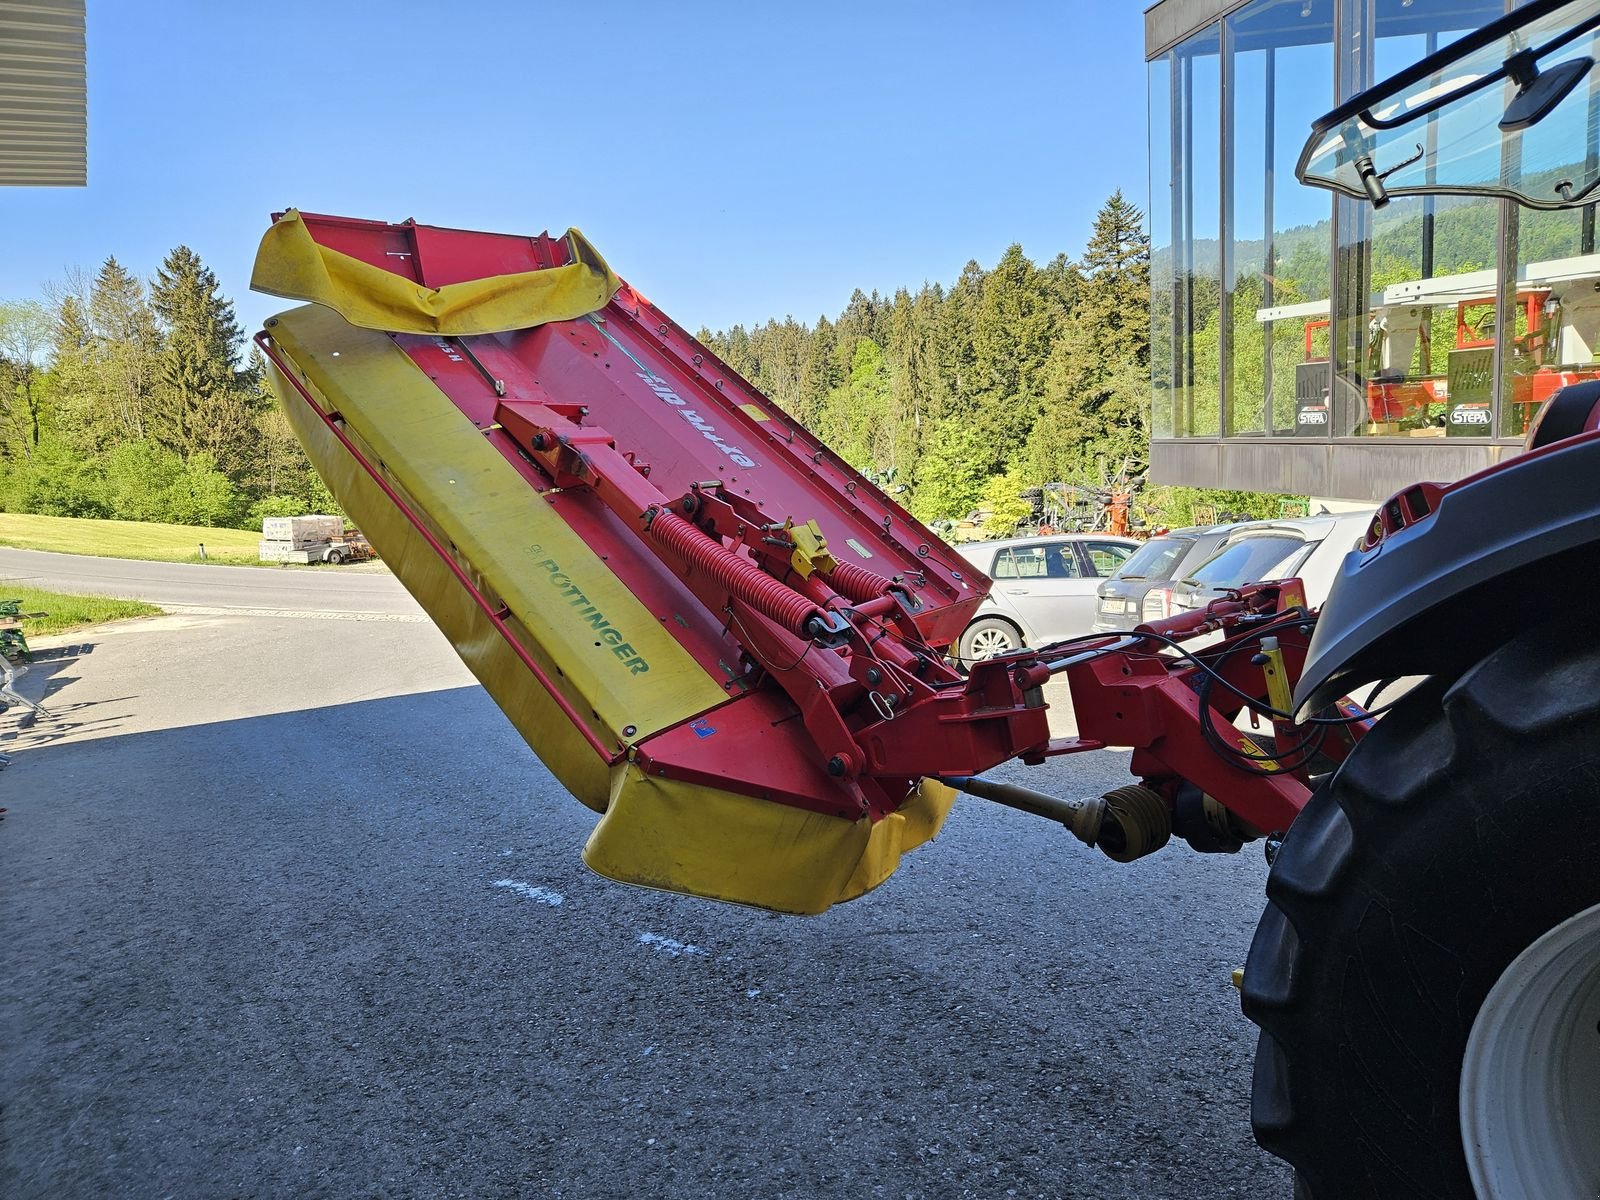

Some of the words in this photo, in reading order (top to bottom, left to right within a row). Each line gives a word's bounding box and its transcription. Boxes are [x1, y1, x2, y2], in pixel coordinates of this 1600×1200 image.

[1300, 412, 1326, 424] STEPA
[1453, 411, 1488, 423] STEPA
[677, 409, 757, 467] extra
[536, 559, 650, 676] PÖTTINGER
